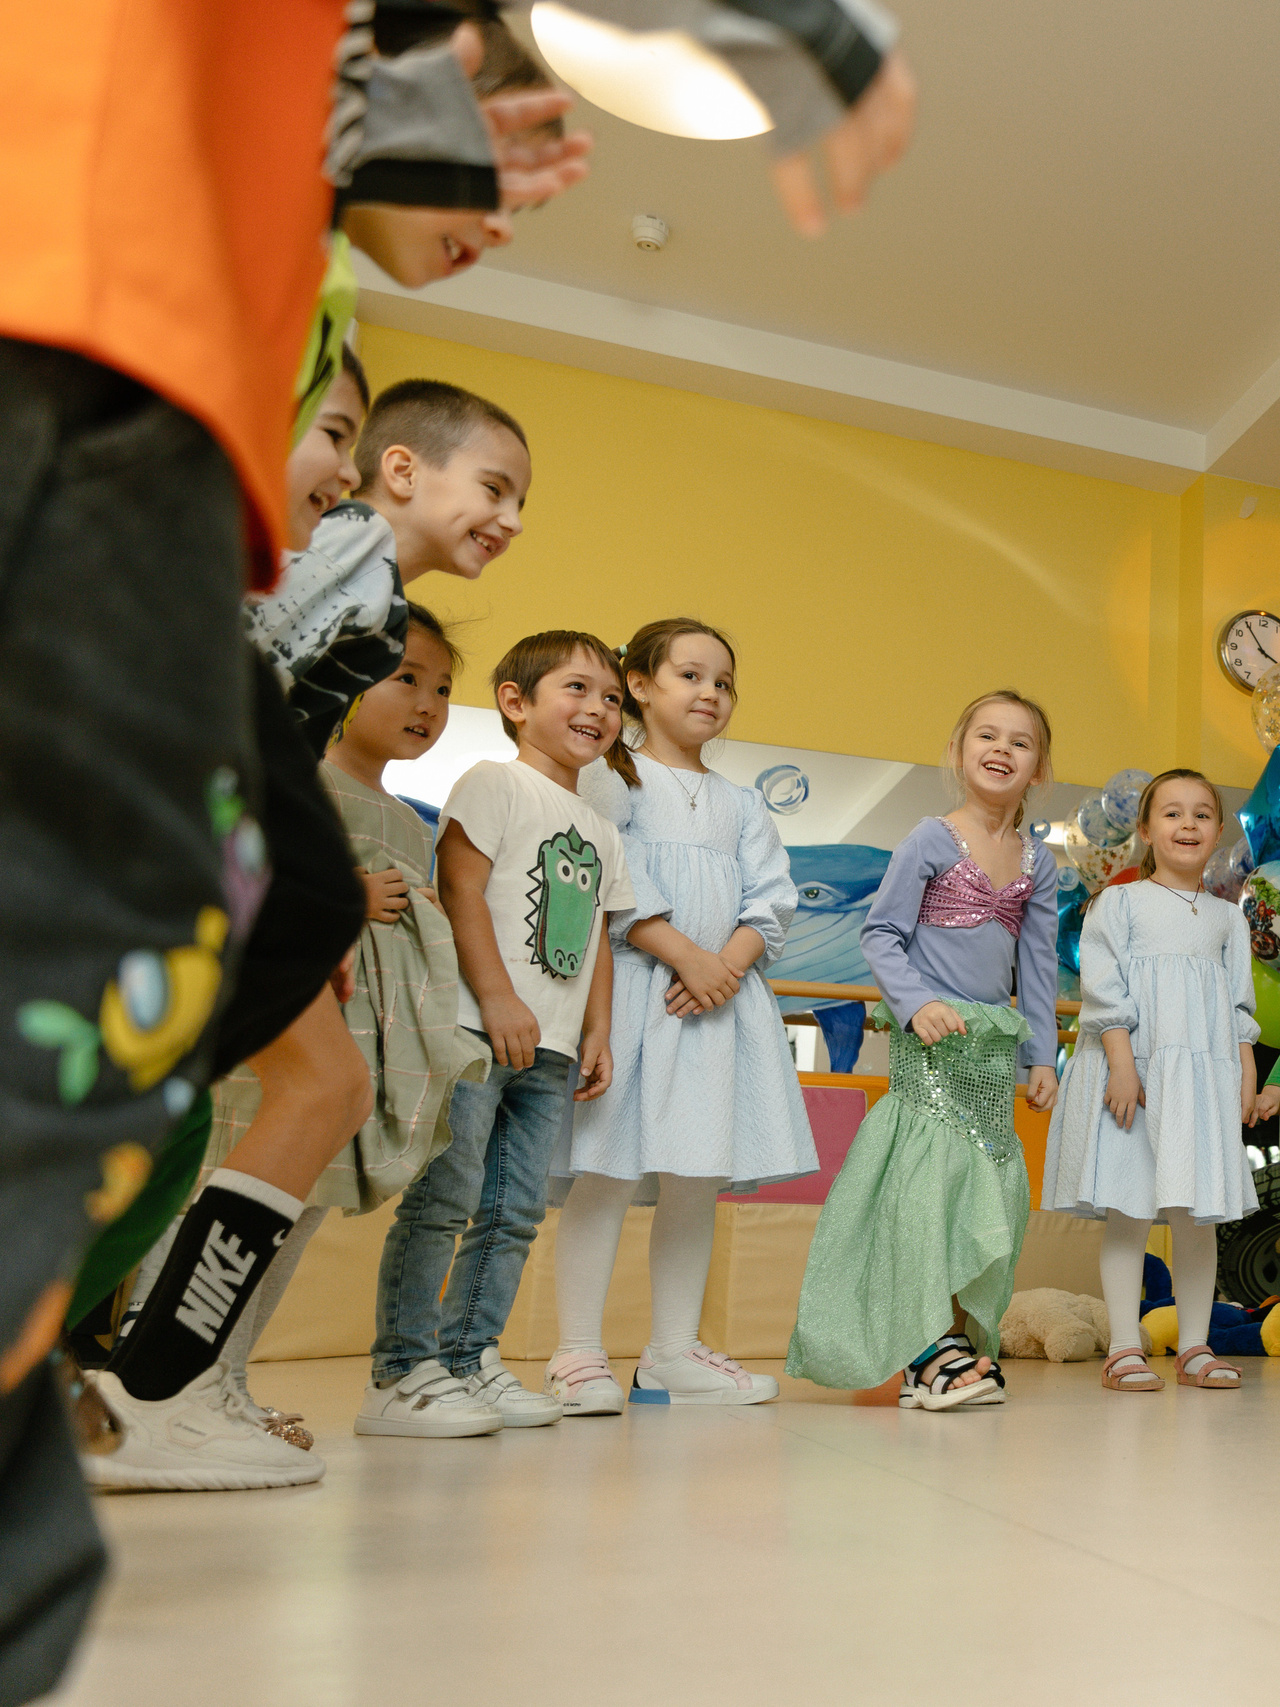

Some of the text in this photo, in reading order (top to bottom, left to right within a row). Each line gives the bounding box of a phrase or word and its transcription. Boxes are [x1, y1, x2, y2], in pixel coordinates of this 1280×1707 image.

[1259, 619, 1269, 628] 12
[1235, 629, 1244, 637] 10
[1275, 626, 1279, 634] 1
[1230, 642, 1238, 650] 9
[1234, 658, 1243, 666] 8
[1244, 670, 1251, 679] 7
[175, 1219, 257, 1344] NIKE
